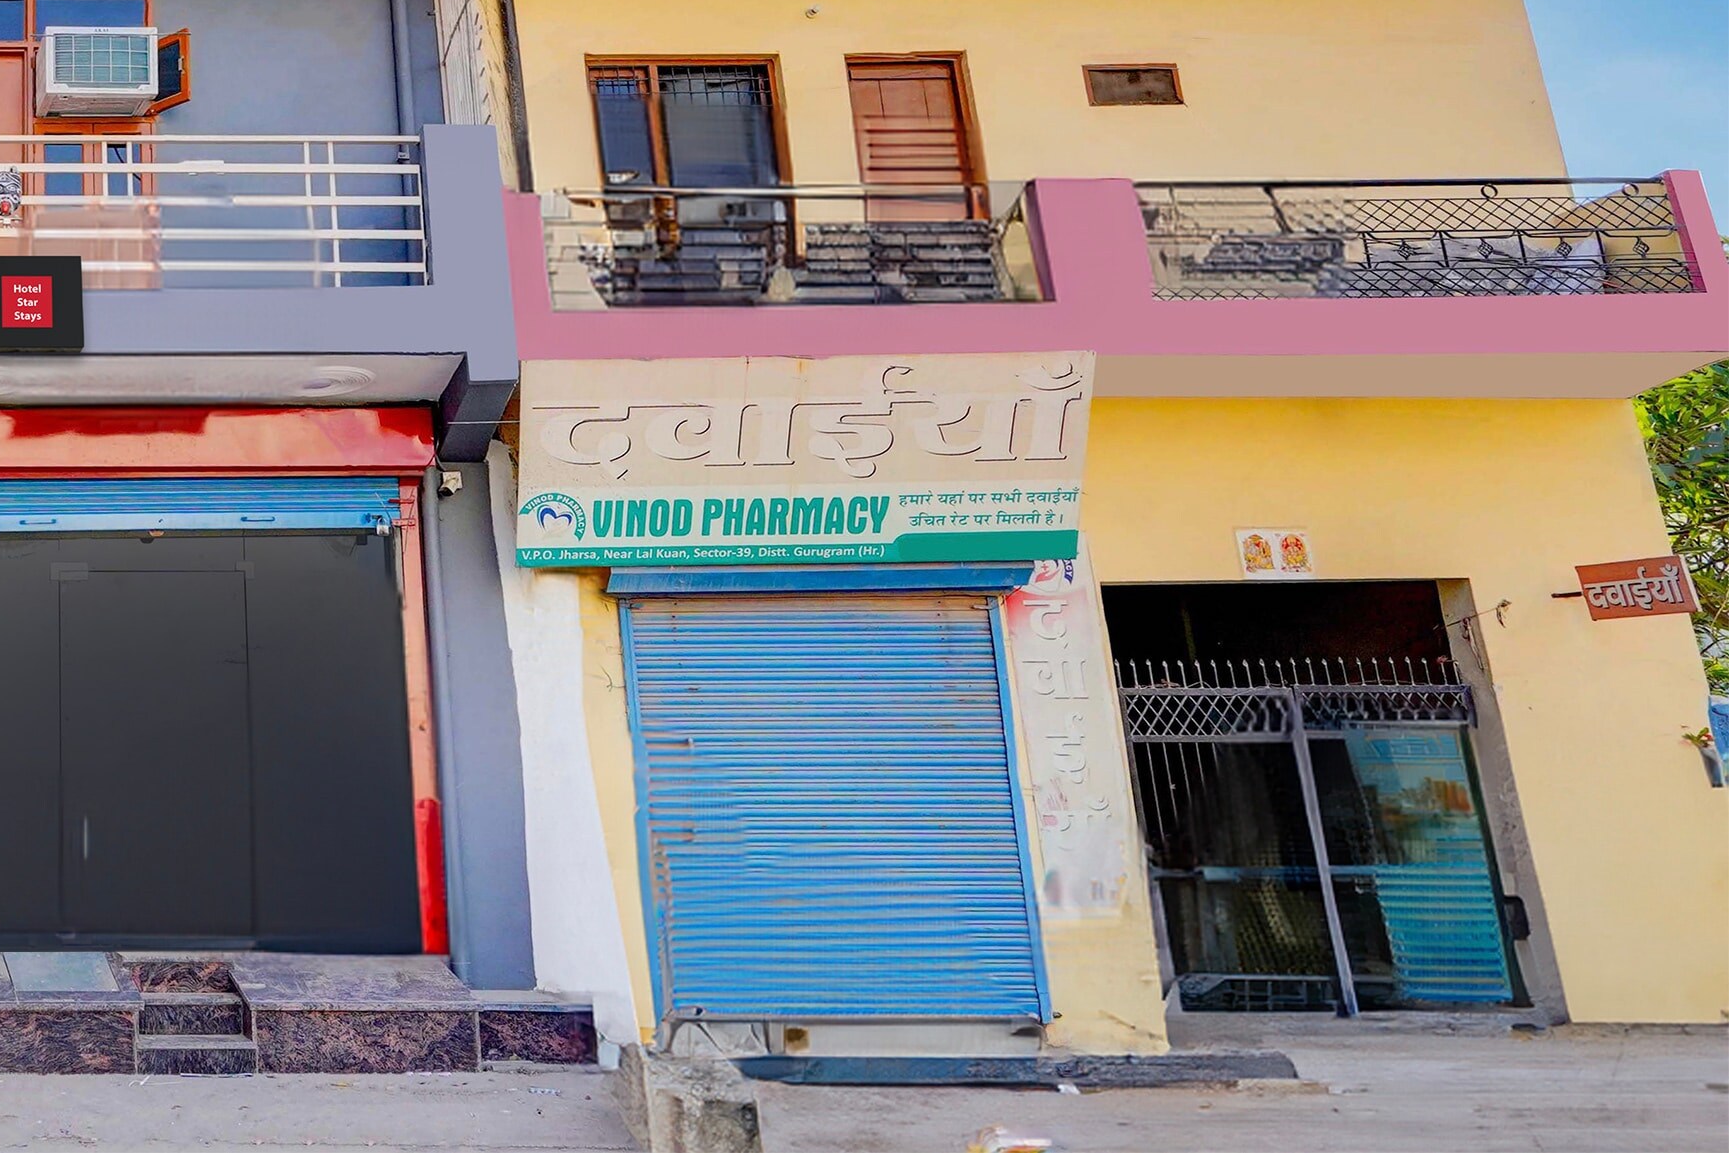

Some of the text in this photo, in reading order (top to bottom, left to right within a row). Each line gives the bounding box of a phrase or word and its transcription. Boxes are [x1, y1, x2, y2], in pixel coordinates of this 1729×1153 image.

[13, 283, 42, 294] Hotel
[17, 297, 38, 307] Star
[14, 311, 42, 322] Stays
[898, 489, 934, 508] हमारे
[968, 492, 987, 506] पर
[990, 488, 1023, 504] सभी
[1026, 486, 1080, 506] दवाईयाँ
[525, 494, 585, 534] VINOD PHARMACY
[593, 496, 890, 538] VINOD PHARMACY
[909, 512, 946, 527] उचित
[950, 511, 970, 526] रेट
[973, 515, 992, 526] पर
[996, 510, 1041, 525] मिलती
[522, 545, 885, 562] V.P.O. Jharsa, Near Lal Kuan, Sector-39, Distt. Gurugram (Hr.)
[1582, 564, 1685, 610] दवाईयाँ
